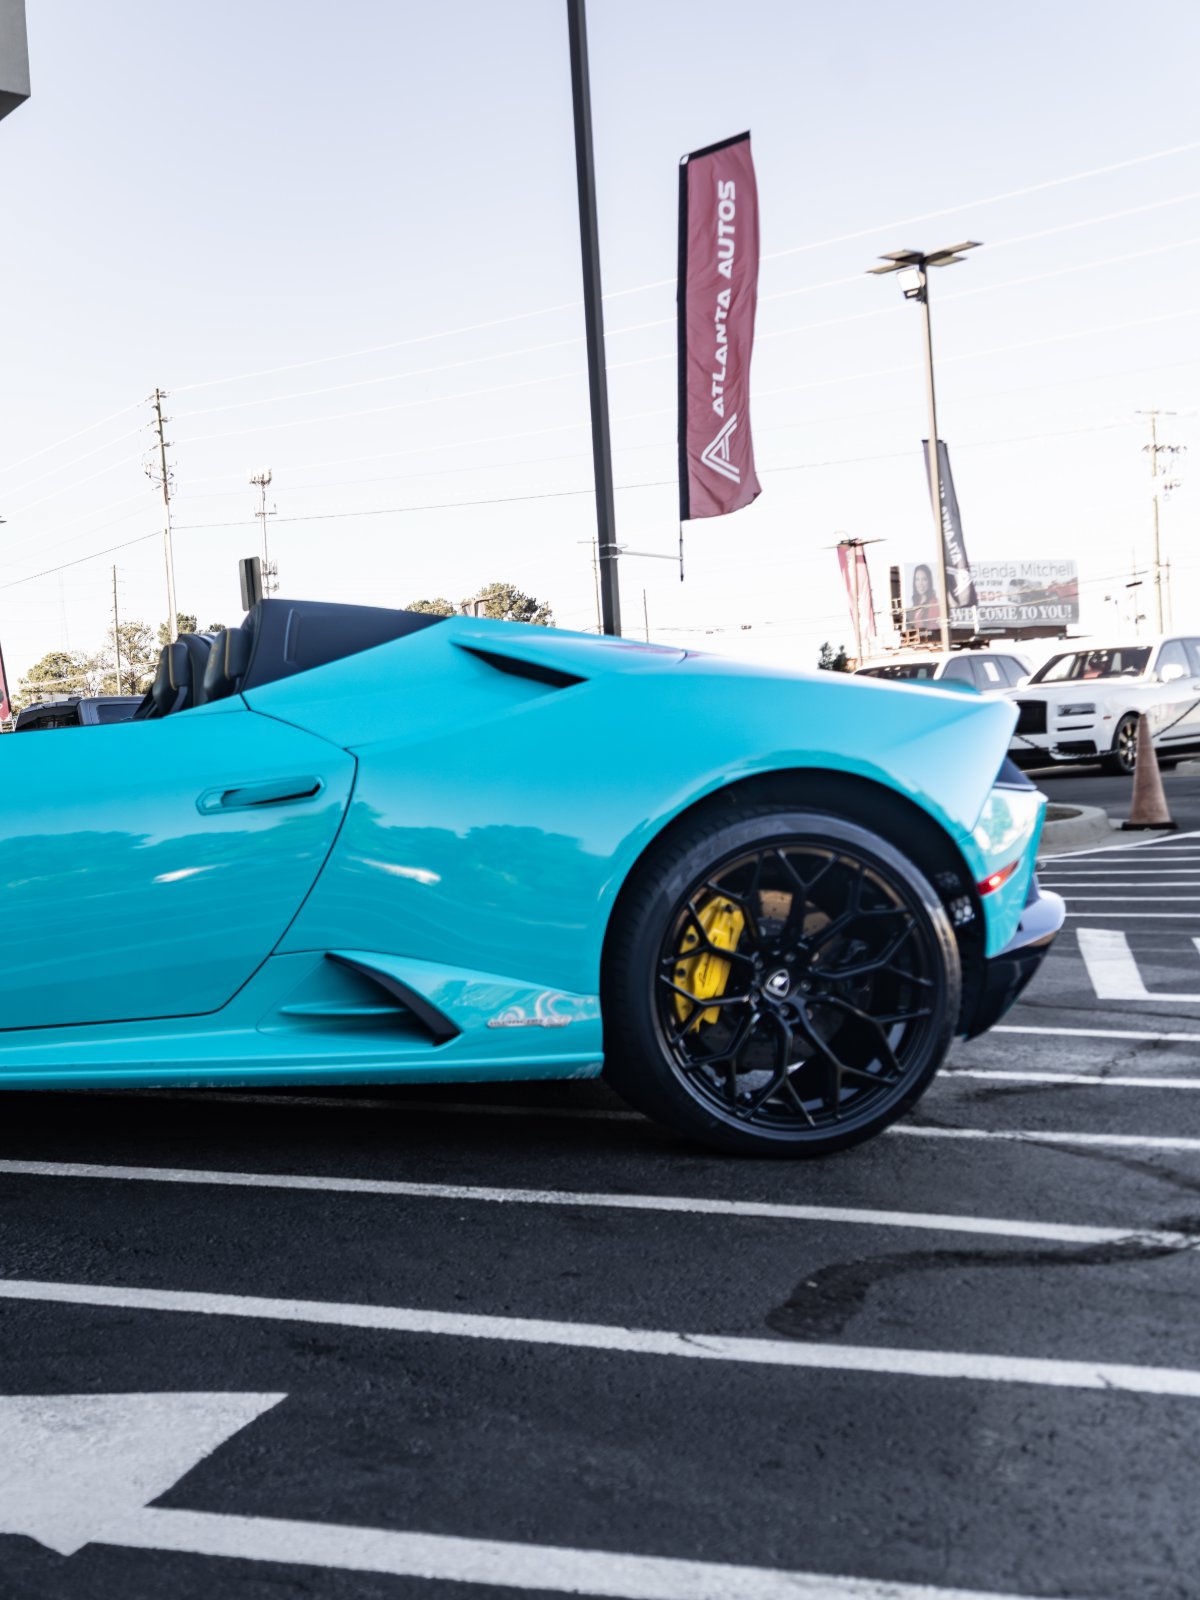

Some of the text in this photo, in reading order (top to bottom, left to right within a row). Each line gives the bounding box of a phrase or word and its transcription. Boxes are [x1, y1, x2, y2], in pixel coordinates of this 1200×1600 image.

[711, 180, 736, 418] ATLANTA AUTOS
[970, 561, 1074, 579] Glenda Mitchell
[1019, 606, 1038, 620] TO
[1039, 604, 1072, 619] YOU!
